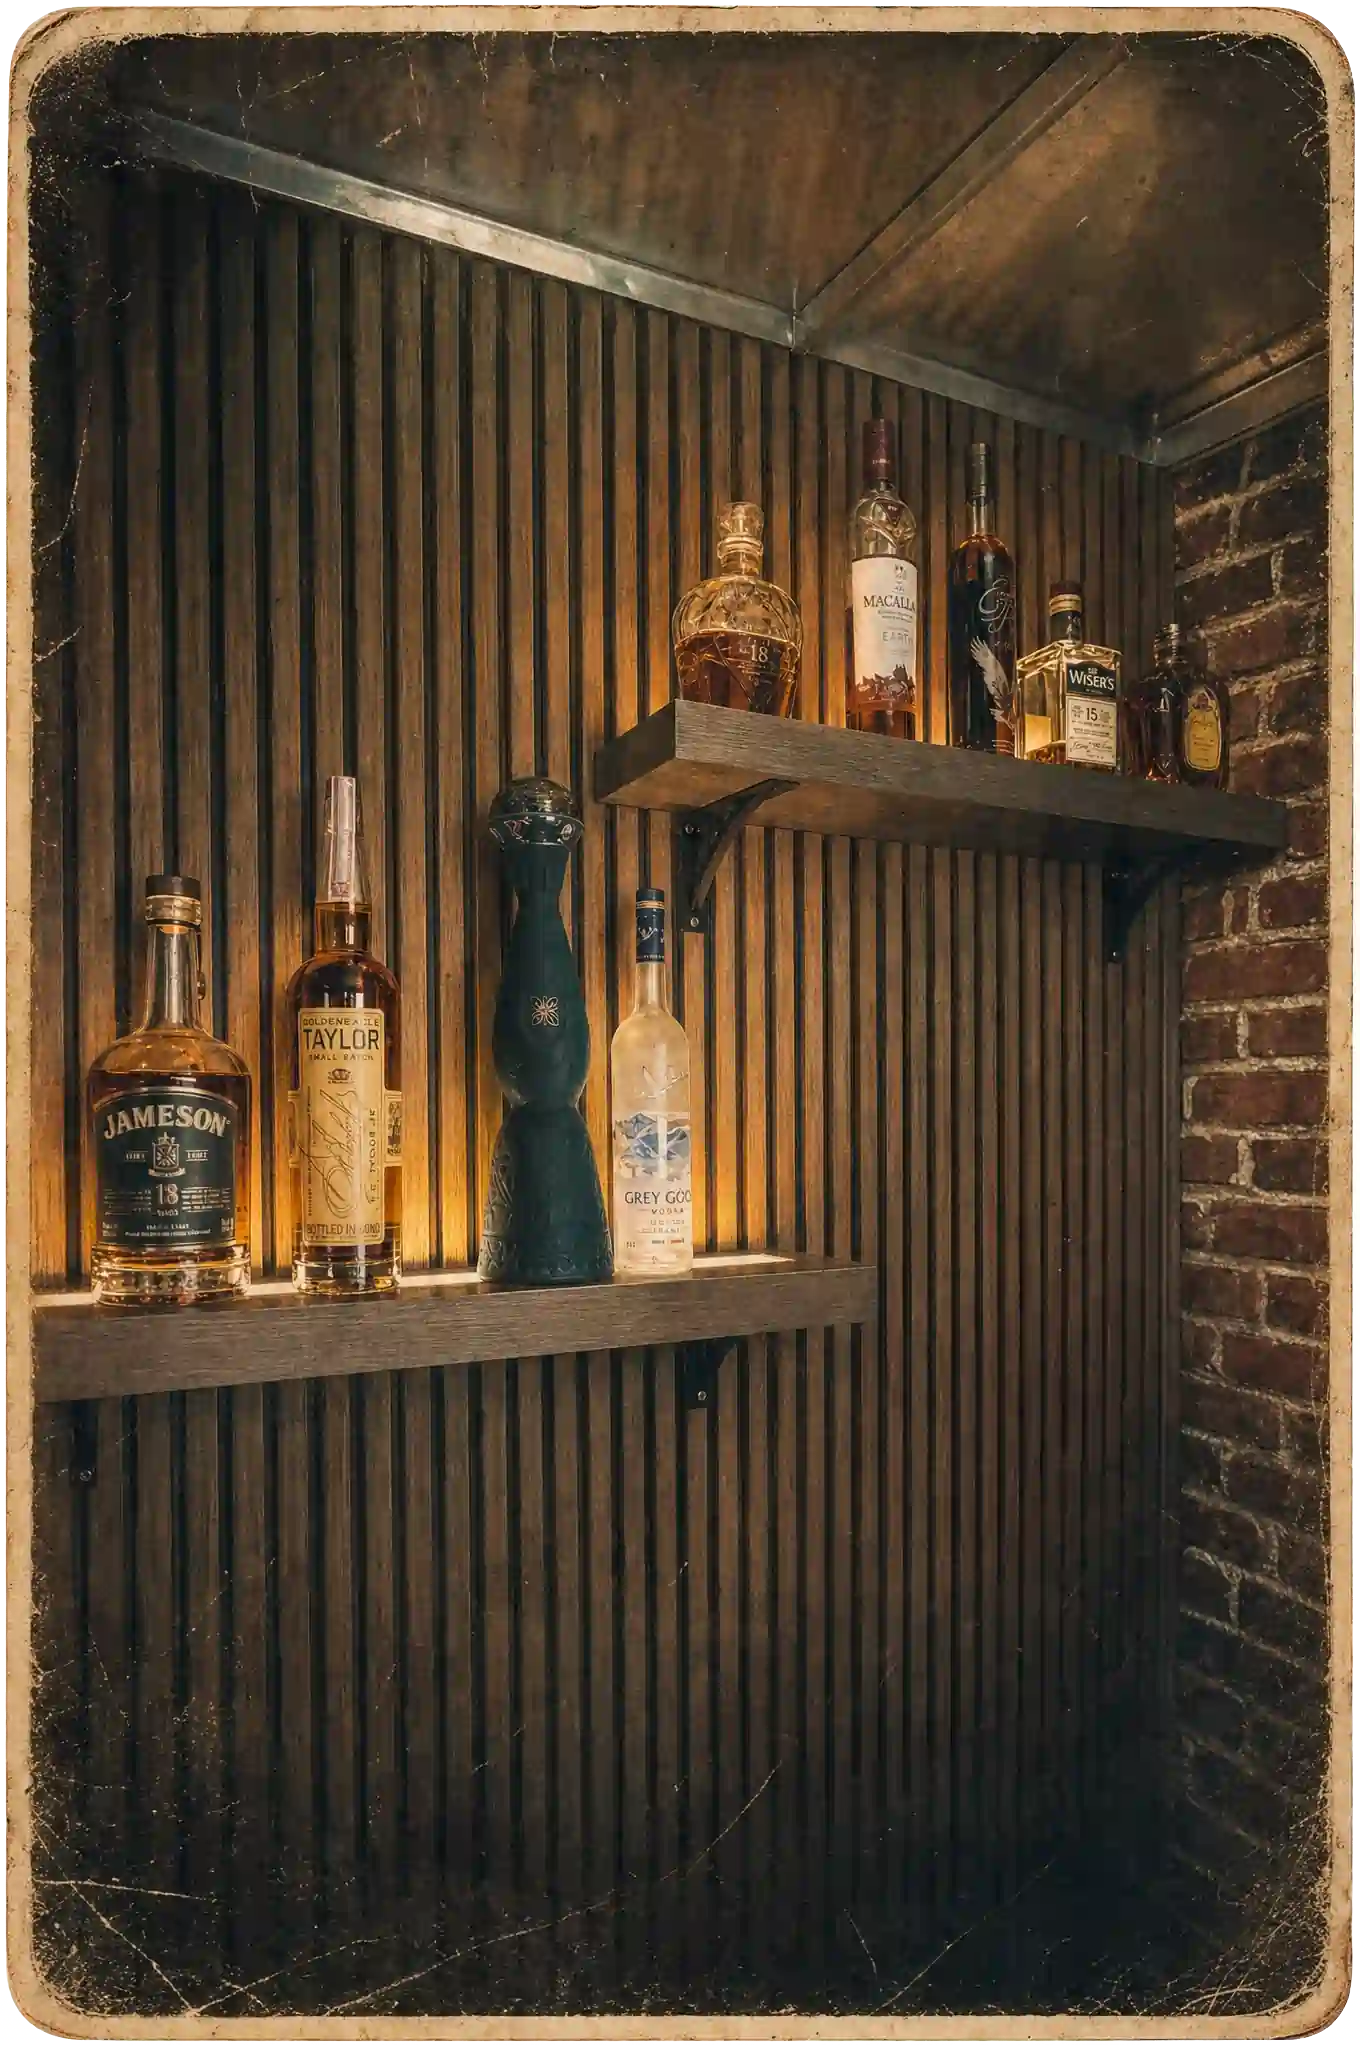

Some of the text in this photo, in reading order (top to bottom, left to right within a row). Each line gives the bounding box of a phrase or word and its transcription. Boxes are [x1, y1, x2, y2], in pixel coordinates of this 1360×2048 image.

[751, 642, 769, 662] 18
[1069, 669, 1115, 690] WISER'S
[1086, 707, 1098, 721] 15
[303, 1028, 380, 1050] TAYLOR
[104, 1104, 226, 1139] JAMESON
[156, 1183, 179, 1205] 18
[625, 1191, 660, 1204] GREY
[307, 1223, 343, 1235] BOTTLED
[346, 1223, 356, 1235] IN
